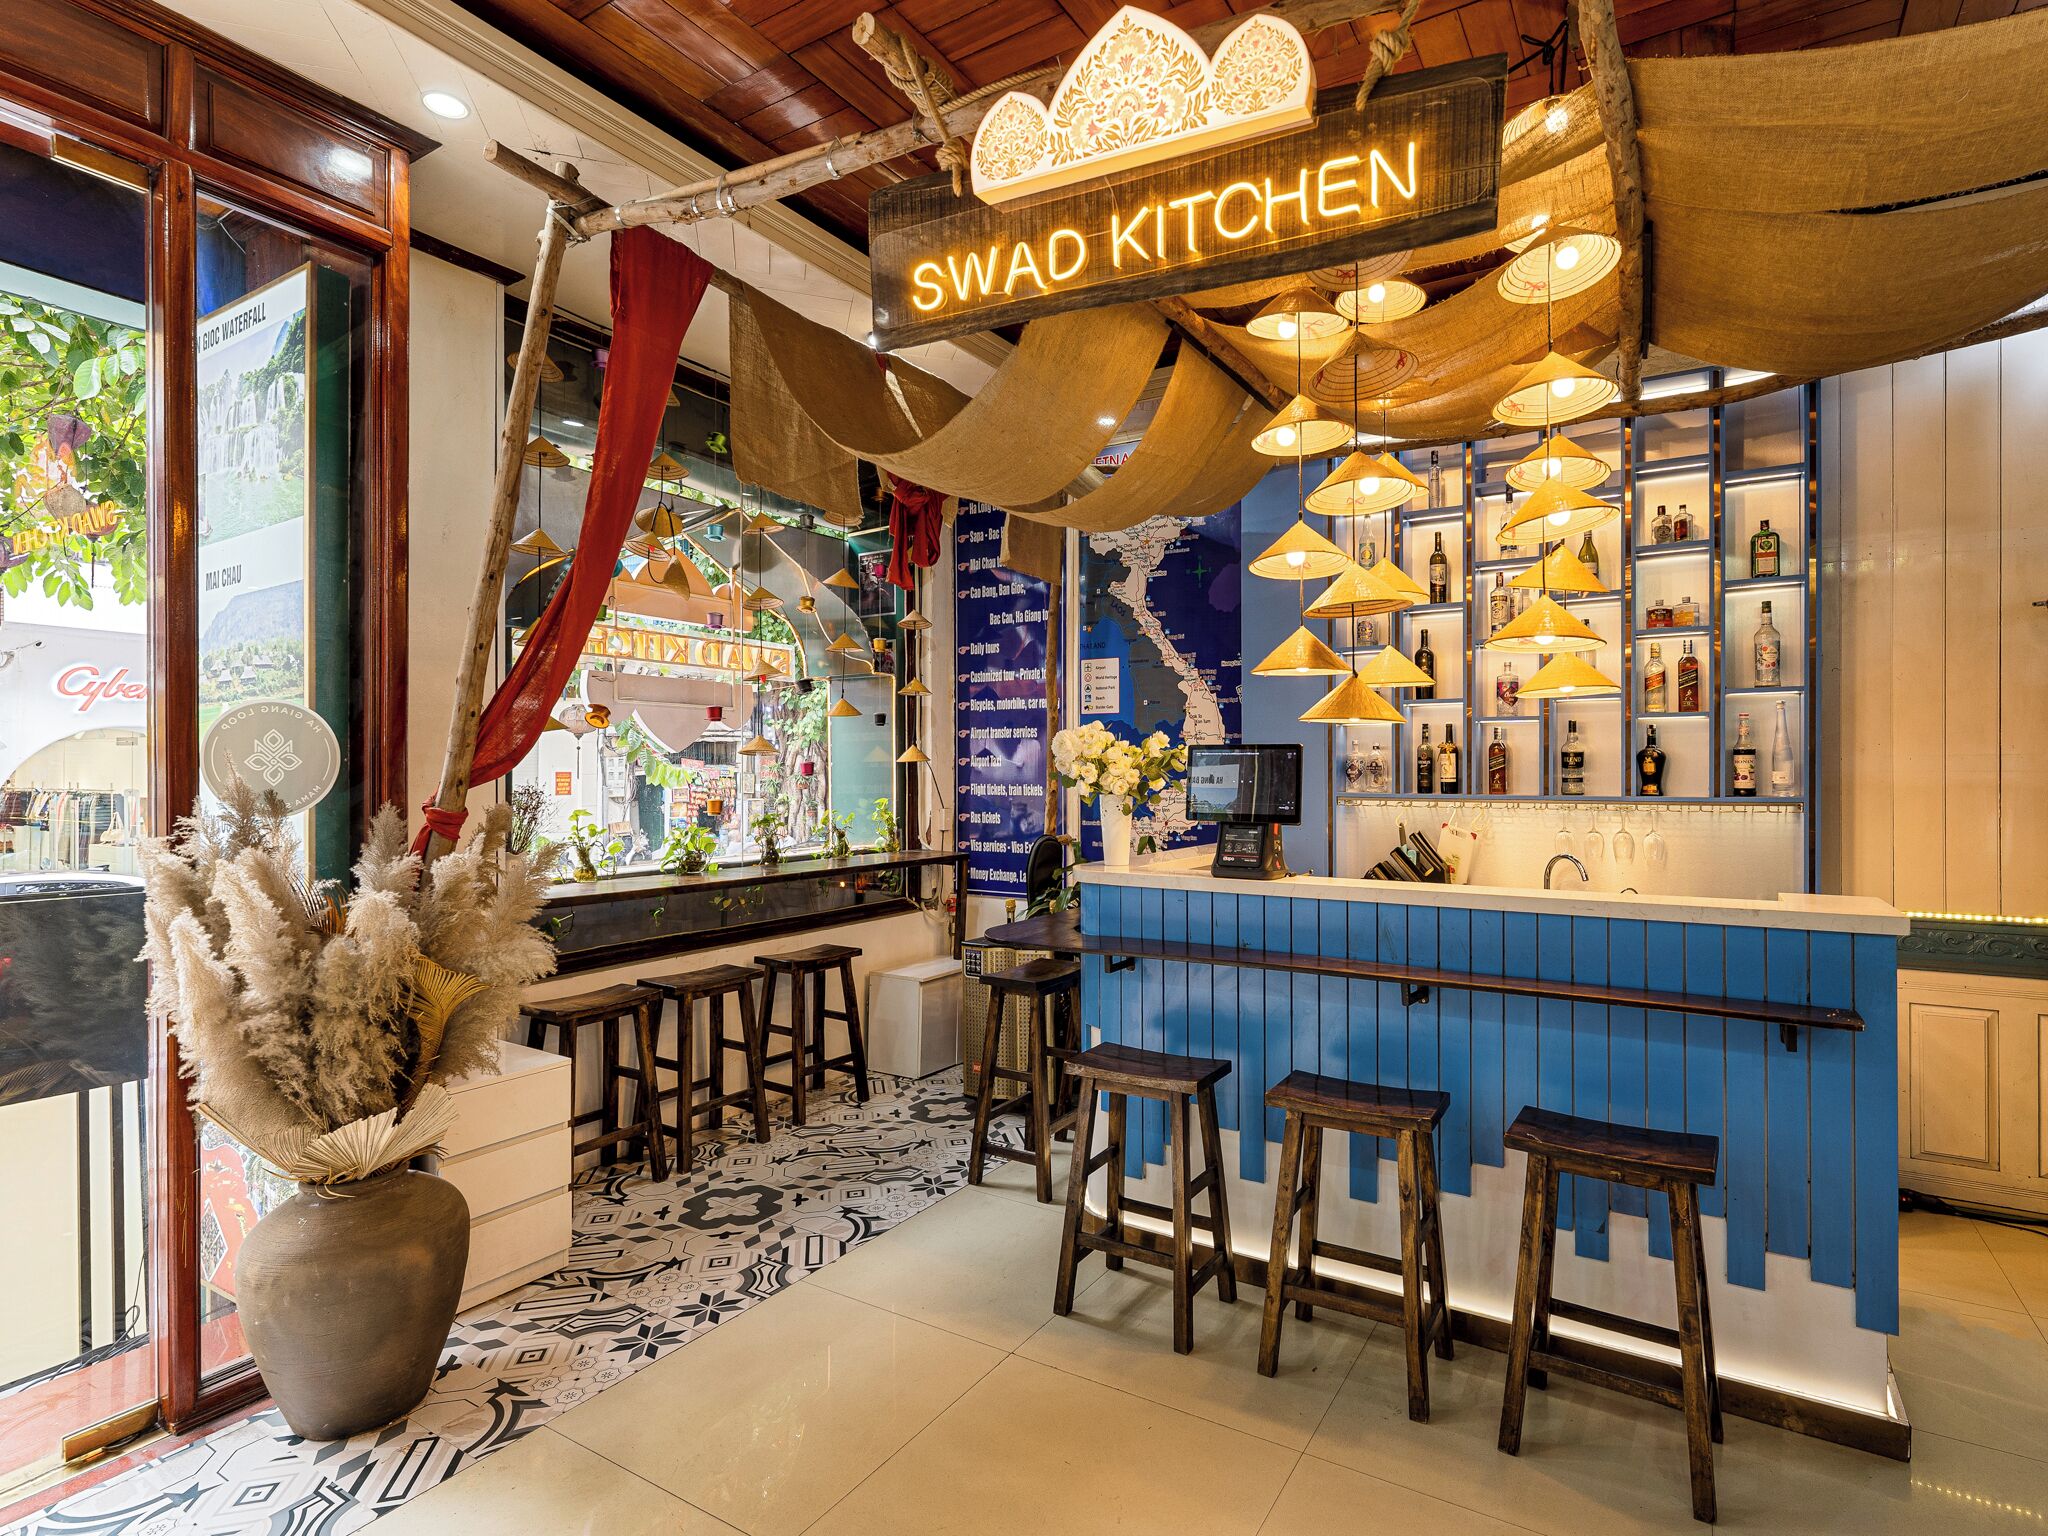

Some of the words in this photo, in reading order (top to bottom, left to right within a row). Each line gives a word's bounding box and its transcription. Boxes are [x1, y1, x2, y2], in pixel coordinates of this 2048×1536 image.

[912, 229, 1088, 311] SWAD
[1110, 141, 1418, 269] KITCHEN
[202, 326, 220, 351] GIOC
[222, 302, 266, 341] WATERFALL
[1095, 452, 1129, 465] ETNA
[970, 530, 984, 544] Sapa
[988, 528, 1000, 540] Bac
[970, 558, 980, 571] Mai
[982, 556, 996, 570] Chau
[206, 570, 220, 592] MAI
[222, 564, 242, 588] CHAU
[998, 584, 1010, 596] Ban
[990, 612, 1000, 626] Bac
[1002, 612, 1014, 624] Can,
[1016, 611, 1024, 623] Ha
[1024, 610, 1042, 623] Giang
[970, 642, 984, 656] Daily
[986, 642, 1000, 654] tours
[970, 670, 1002, 683] Customized
[1003, 669, 1015, 682] tour
[1020, 668, 1040, 680] Private
[970, 698, 996, 712] Bicycles,
[996, 696, 1027, 710] motorbike,
[1028, 699, 1038, 709] car
[970, 727, 990, 740] Airport
[990, 726, 1012, 738] transfer
[1012, 726, 1038, 738] services
[970, 755, 990, 768] Airport
[990, 755, 1002, 767] Taxi
[970, 784, 986, 796] Flight
[986, 784, 1008, 796] tickets,
[1008, 784, 1022, 796] train
[1023, 784, 1044, 796] tickets
[970, 812, 981, 824] Bus
[982, 812, 1000, 824] tickets
[970, 840, 983, 852] Visa
[983, 840, 1006, 853] services
[1012, 841, 1024, 854] Visa
[970, 868, 989, 881] Money
[990, 868, 1018, 884] Exchange,
